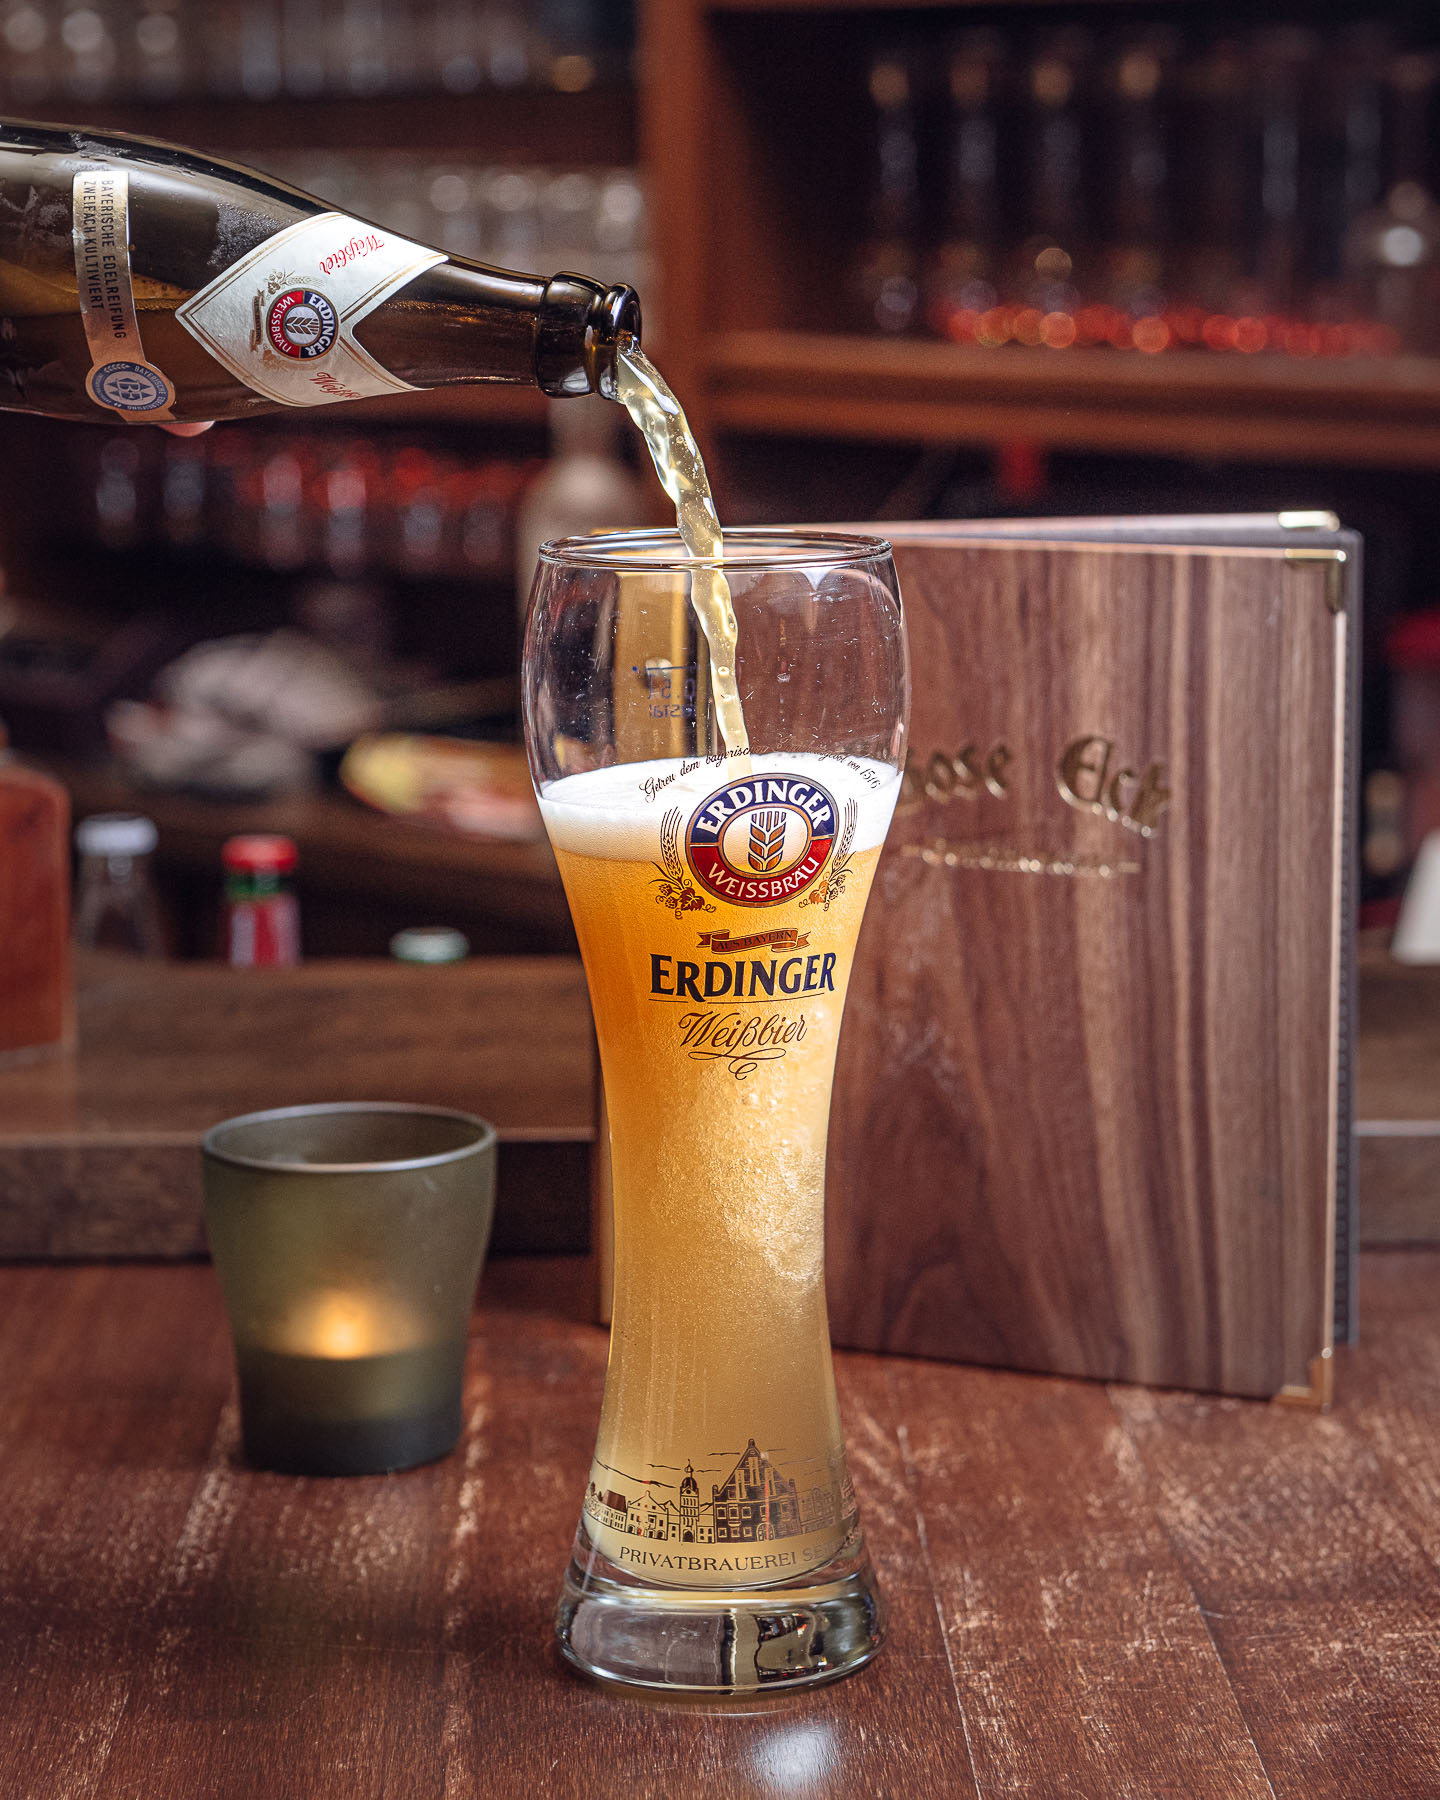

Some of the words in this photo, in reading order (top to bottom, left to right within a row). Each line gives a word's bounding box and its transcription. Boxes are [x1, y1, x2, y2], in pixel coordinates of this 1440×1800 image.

[83, 181, 97, 233] ZWEIFACH
[101, 180, 115, 247] BAYERISCHE
[84, 238, 104, 309] KULTIVIERT
[319, 234, 385, 275] Weißbier
[102, 255, 127, 339] EDELREIFUNG
[305, 293, 335, 356] ERDINGER
[638, 776, 677, 803] Getreu
[679, 760, 701, 777] dem
[847, 760, 861, 772] von
[860, 768, 881, 789] 1516
[695, 780, 832, 835] ERDINGER
[708, 856, 820, 899] WEISSBRÄU
[716, 941, 740, 950] AUS
[743, 930, 793, 947] BAYERN
[650, 952, 837, 1002] ERDINGER
[678, 1010, 808, 1057] Weißbier
[619, 1546, 797, 1571] PRIVATBRAUEREI
